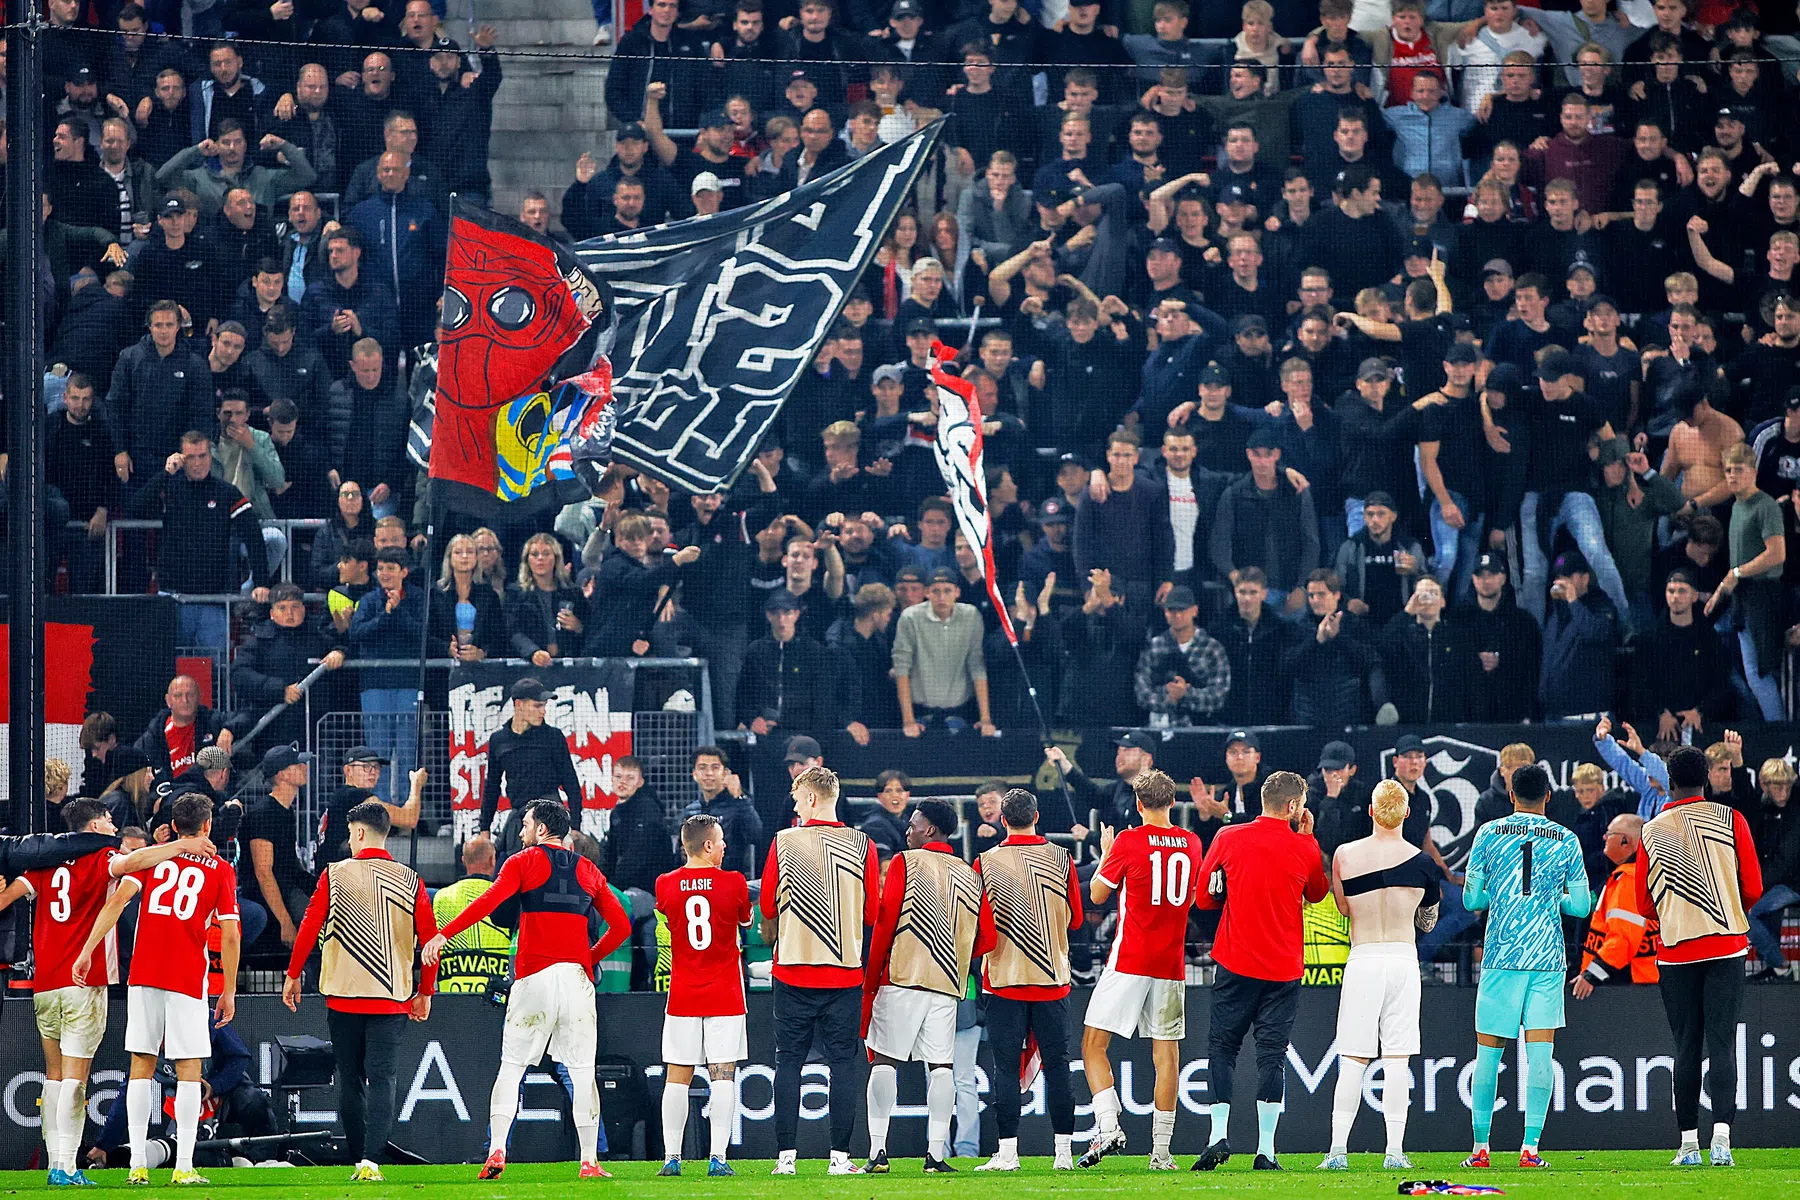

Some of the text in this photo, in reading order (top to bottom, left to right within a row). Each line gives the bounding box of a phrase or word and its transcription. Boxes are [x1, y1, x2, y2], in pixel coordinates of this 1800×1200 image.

[1148, 834, 1188, 848] MIJNANS
[1495, 824, 1564, 842] OWUSU-ODURO
[50, 866, 72, 923] 3
[148, 860, 205, 921] 28
[680, 878, 713, 892] CLASIE
[1149, 850, 1191, 907] 10
[1520, 841, 1533, 896] 1
[685, 894, 712, 951] 8
